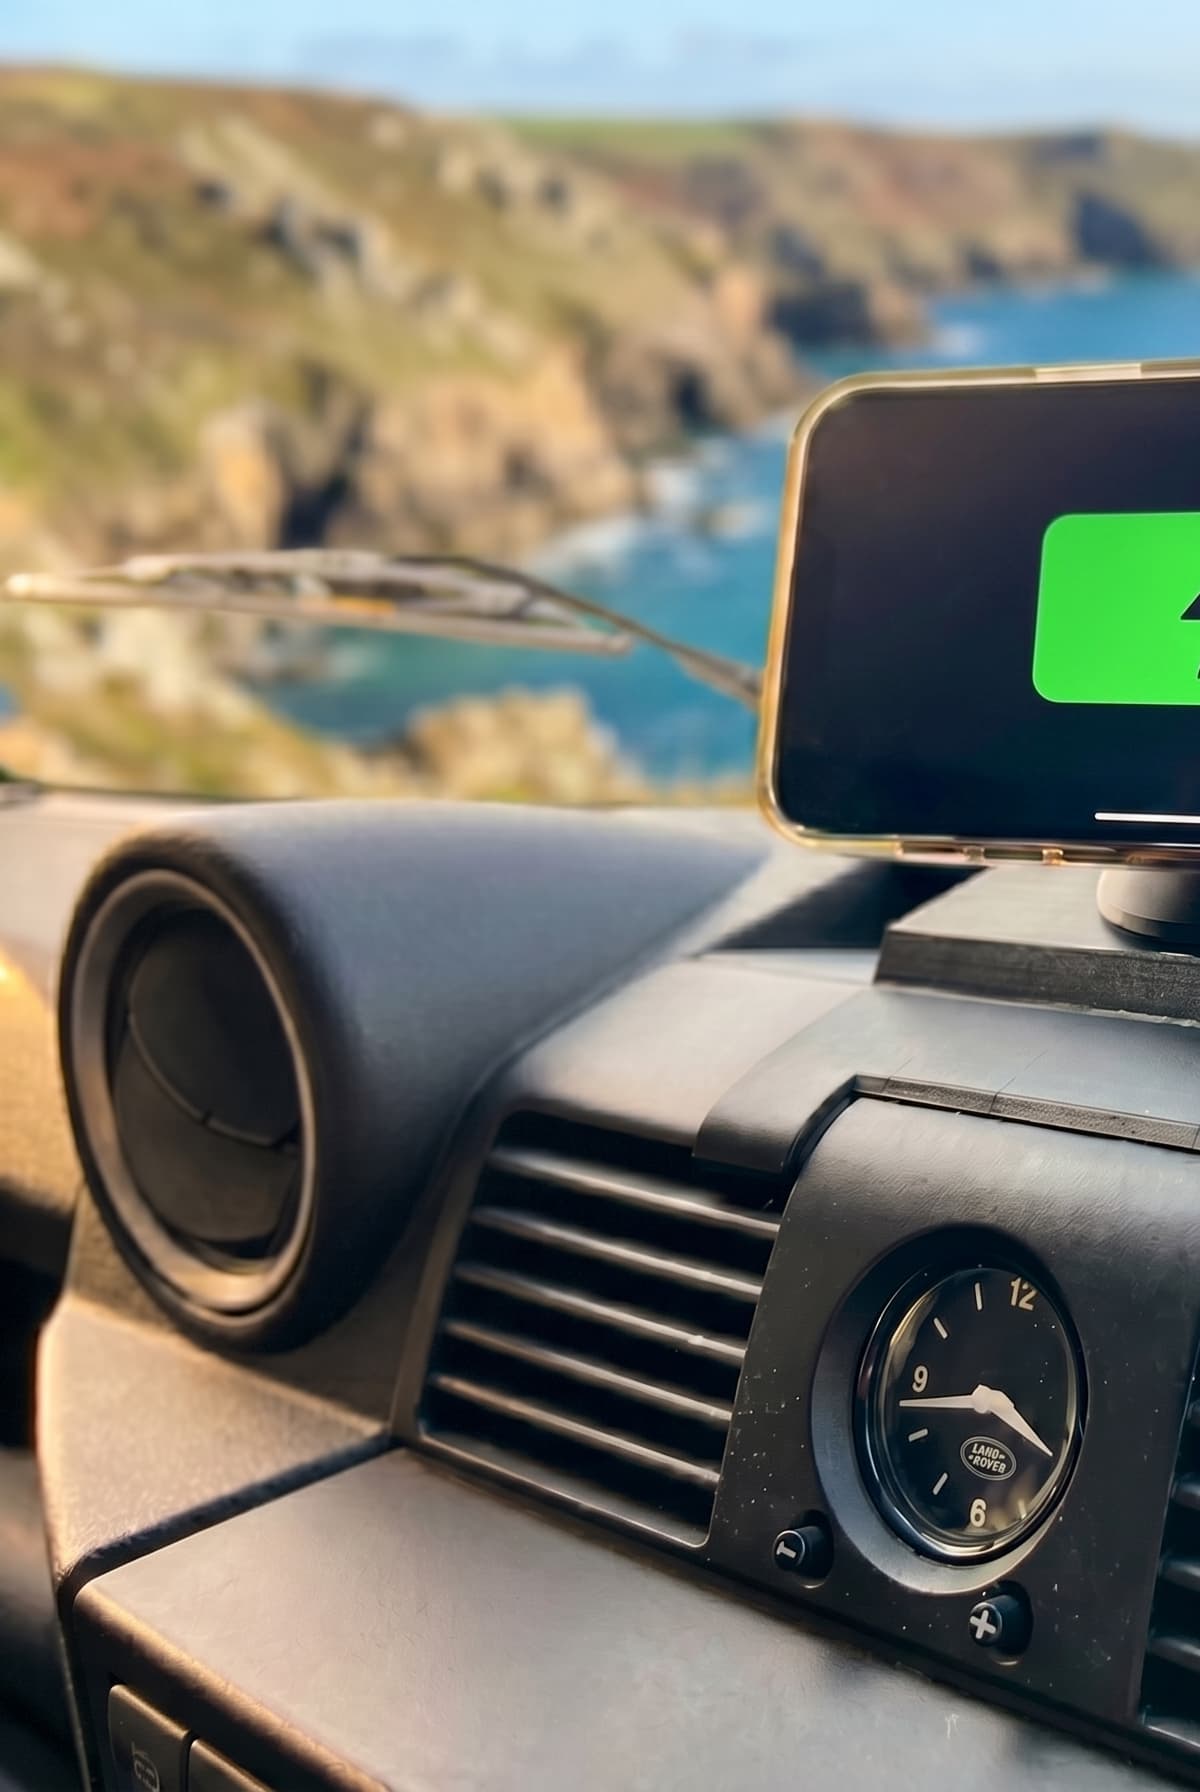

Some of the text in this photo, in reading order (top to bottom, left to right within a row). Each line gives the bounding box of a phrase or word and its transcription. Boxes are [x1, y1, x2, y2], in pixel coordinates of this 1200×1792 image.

[1010, 1277, 1038, 1311] 12
[912, 1365, 929, 1393] 9
[969, 1498, 987, 1528] 6
